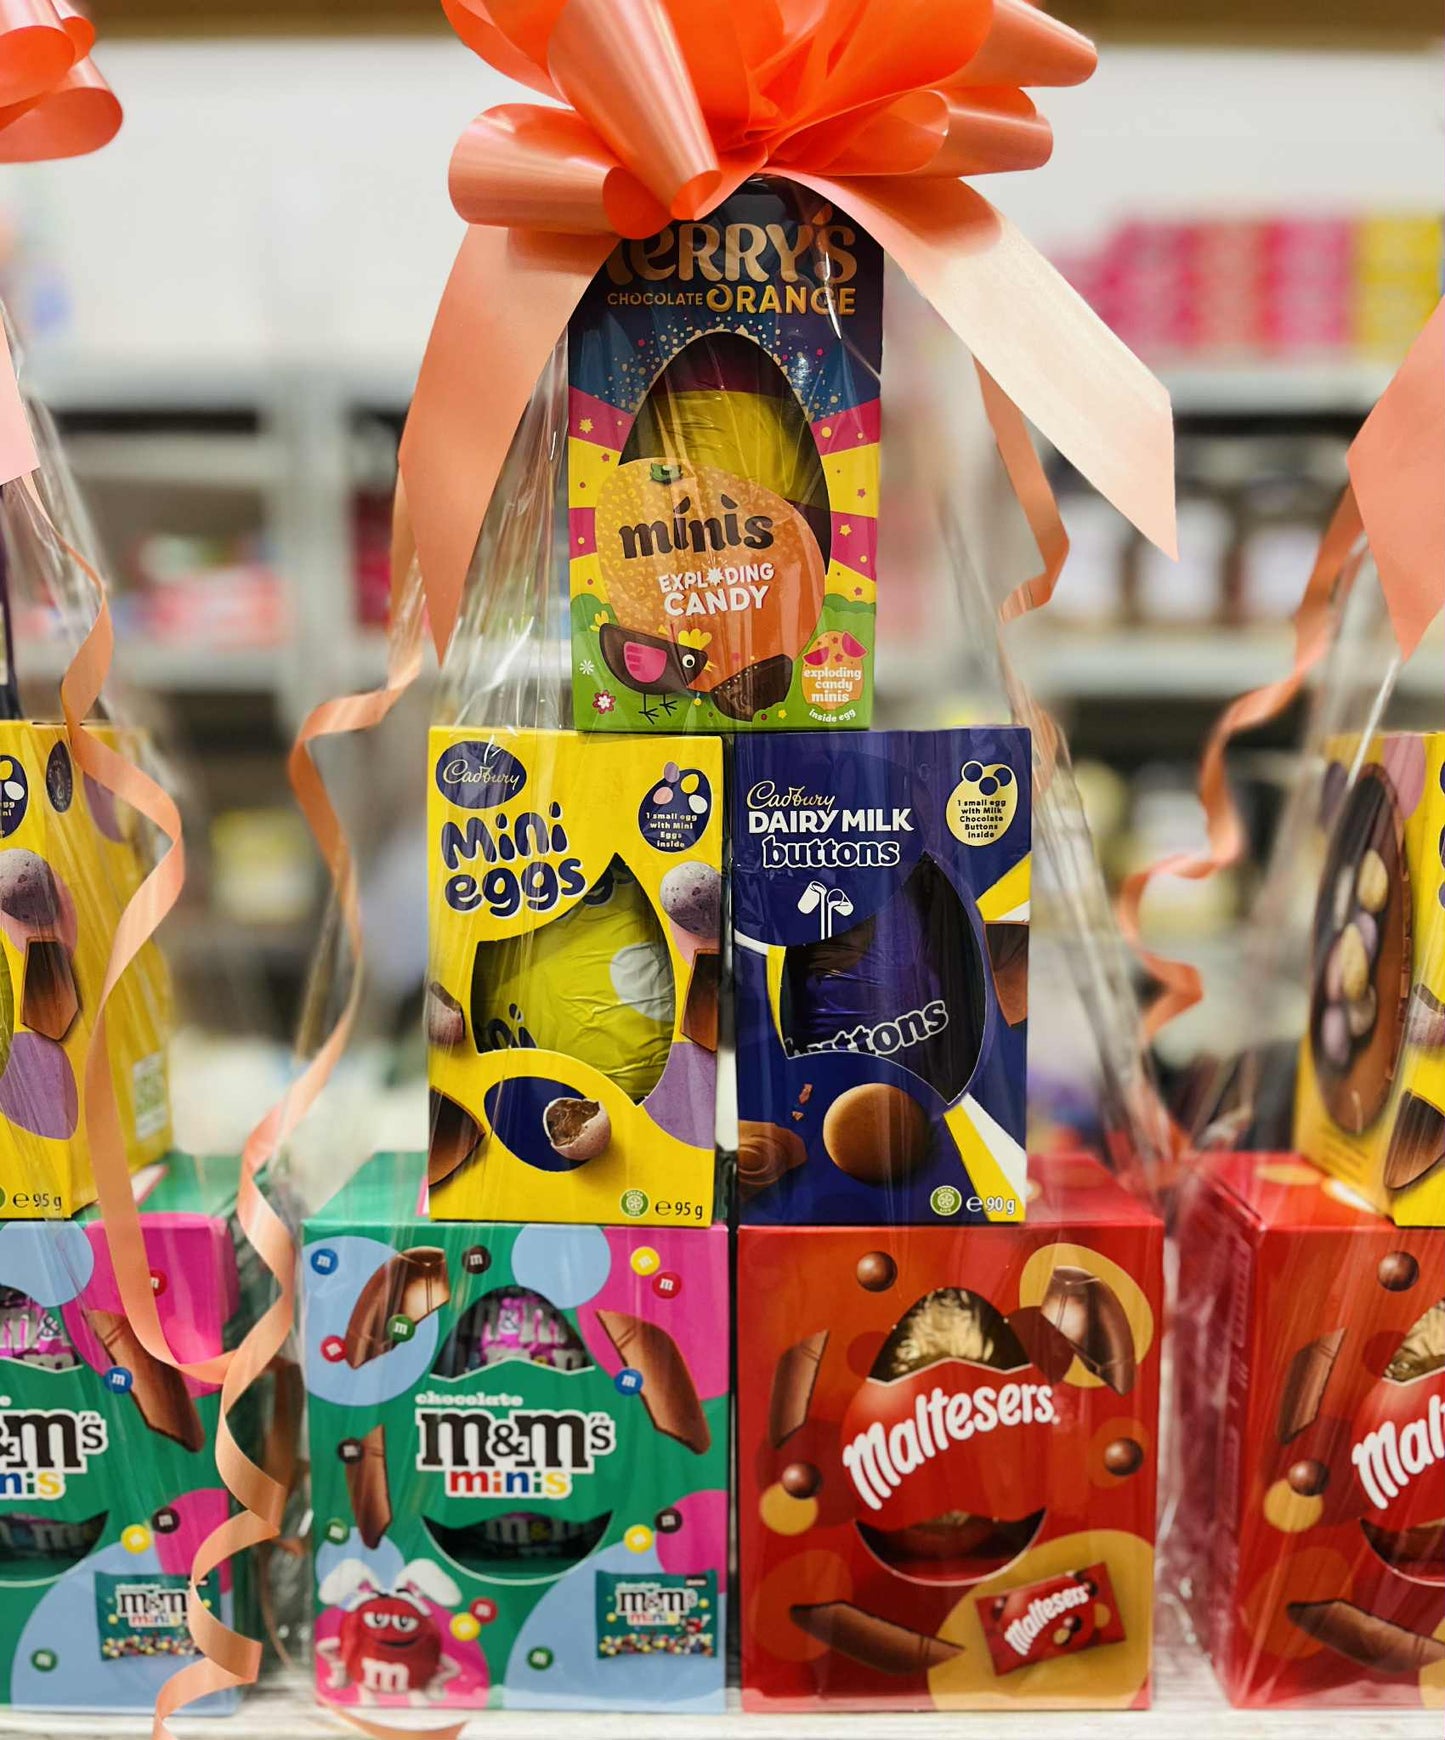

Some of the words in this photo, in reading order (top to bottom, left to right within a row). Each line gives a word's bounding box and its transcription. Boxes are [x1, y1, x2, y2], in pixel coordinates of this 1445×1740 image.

[607, 291, 704, 306] CHOCOLATE
[706, 284, 856, 316] ORANGE
[618, 493, 774, 560] minis
[663, 585, 769, 617] CANDY
[803, 667, 862, 680] exploding
[815, 679, 853, 692] candy
[811, 690, 850, 702] minis
[838, 709, 856, 721] egg
[442, 759, 520, 790] Cadbury
[746, 780, 836, 811] Cadbury
[652, 812, 678, 820] small
[680, 814, 698, 822] egg
[673, 822, 693, 830] Mini
[749, 809, 838, 834] DAIRY
[841, 808, 914, 832] MILK
[959, 815, 1004, 823] Chocolate
[440, 801, 568, 871] Mini
[660, 831, 683, 840] Eggs
[762, 835, 900, 868] buttons
[445, 858, 587, 918] eggs
[33, 1193, 49, 1208] 95
[54, 1196, 62, 1211] g
[675, 1201, 691, 1216] 95
[695, 1204, 703, 1220] g
[986, 1196, 1004, 1212] 90
[1006, 1199, 1015, 1215] g
[659, 1278, 674, 1291] m
[394, 1322, 408, 1335] m
[111, 1373, 126, 1387] m
[621, 1375, 636, 1388] m
[415, 1390, 524, 1406] chocolate
[843, 1383, 1055, 1511] Maltesers
[1351, 1394, 1445, 1510] Mal
[449, 1470, 569, 1495] minis
[1003, 1583, 1090, 1657] Maltesers
[361, 1657, 409, 1693] m
